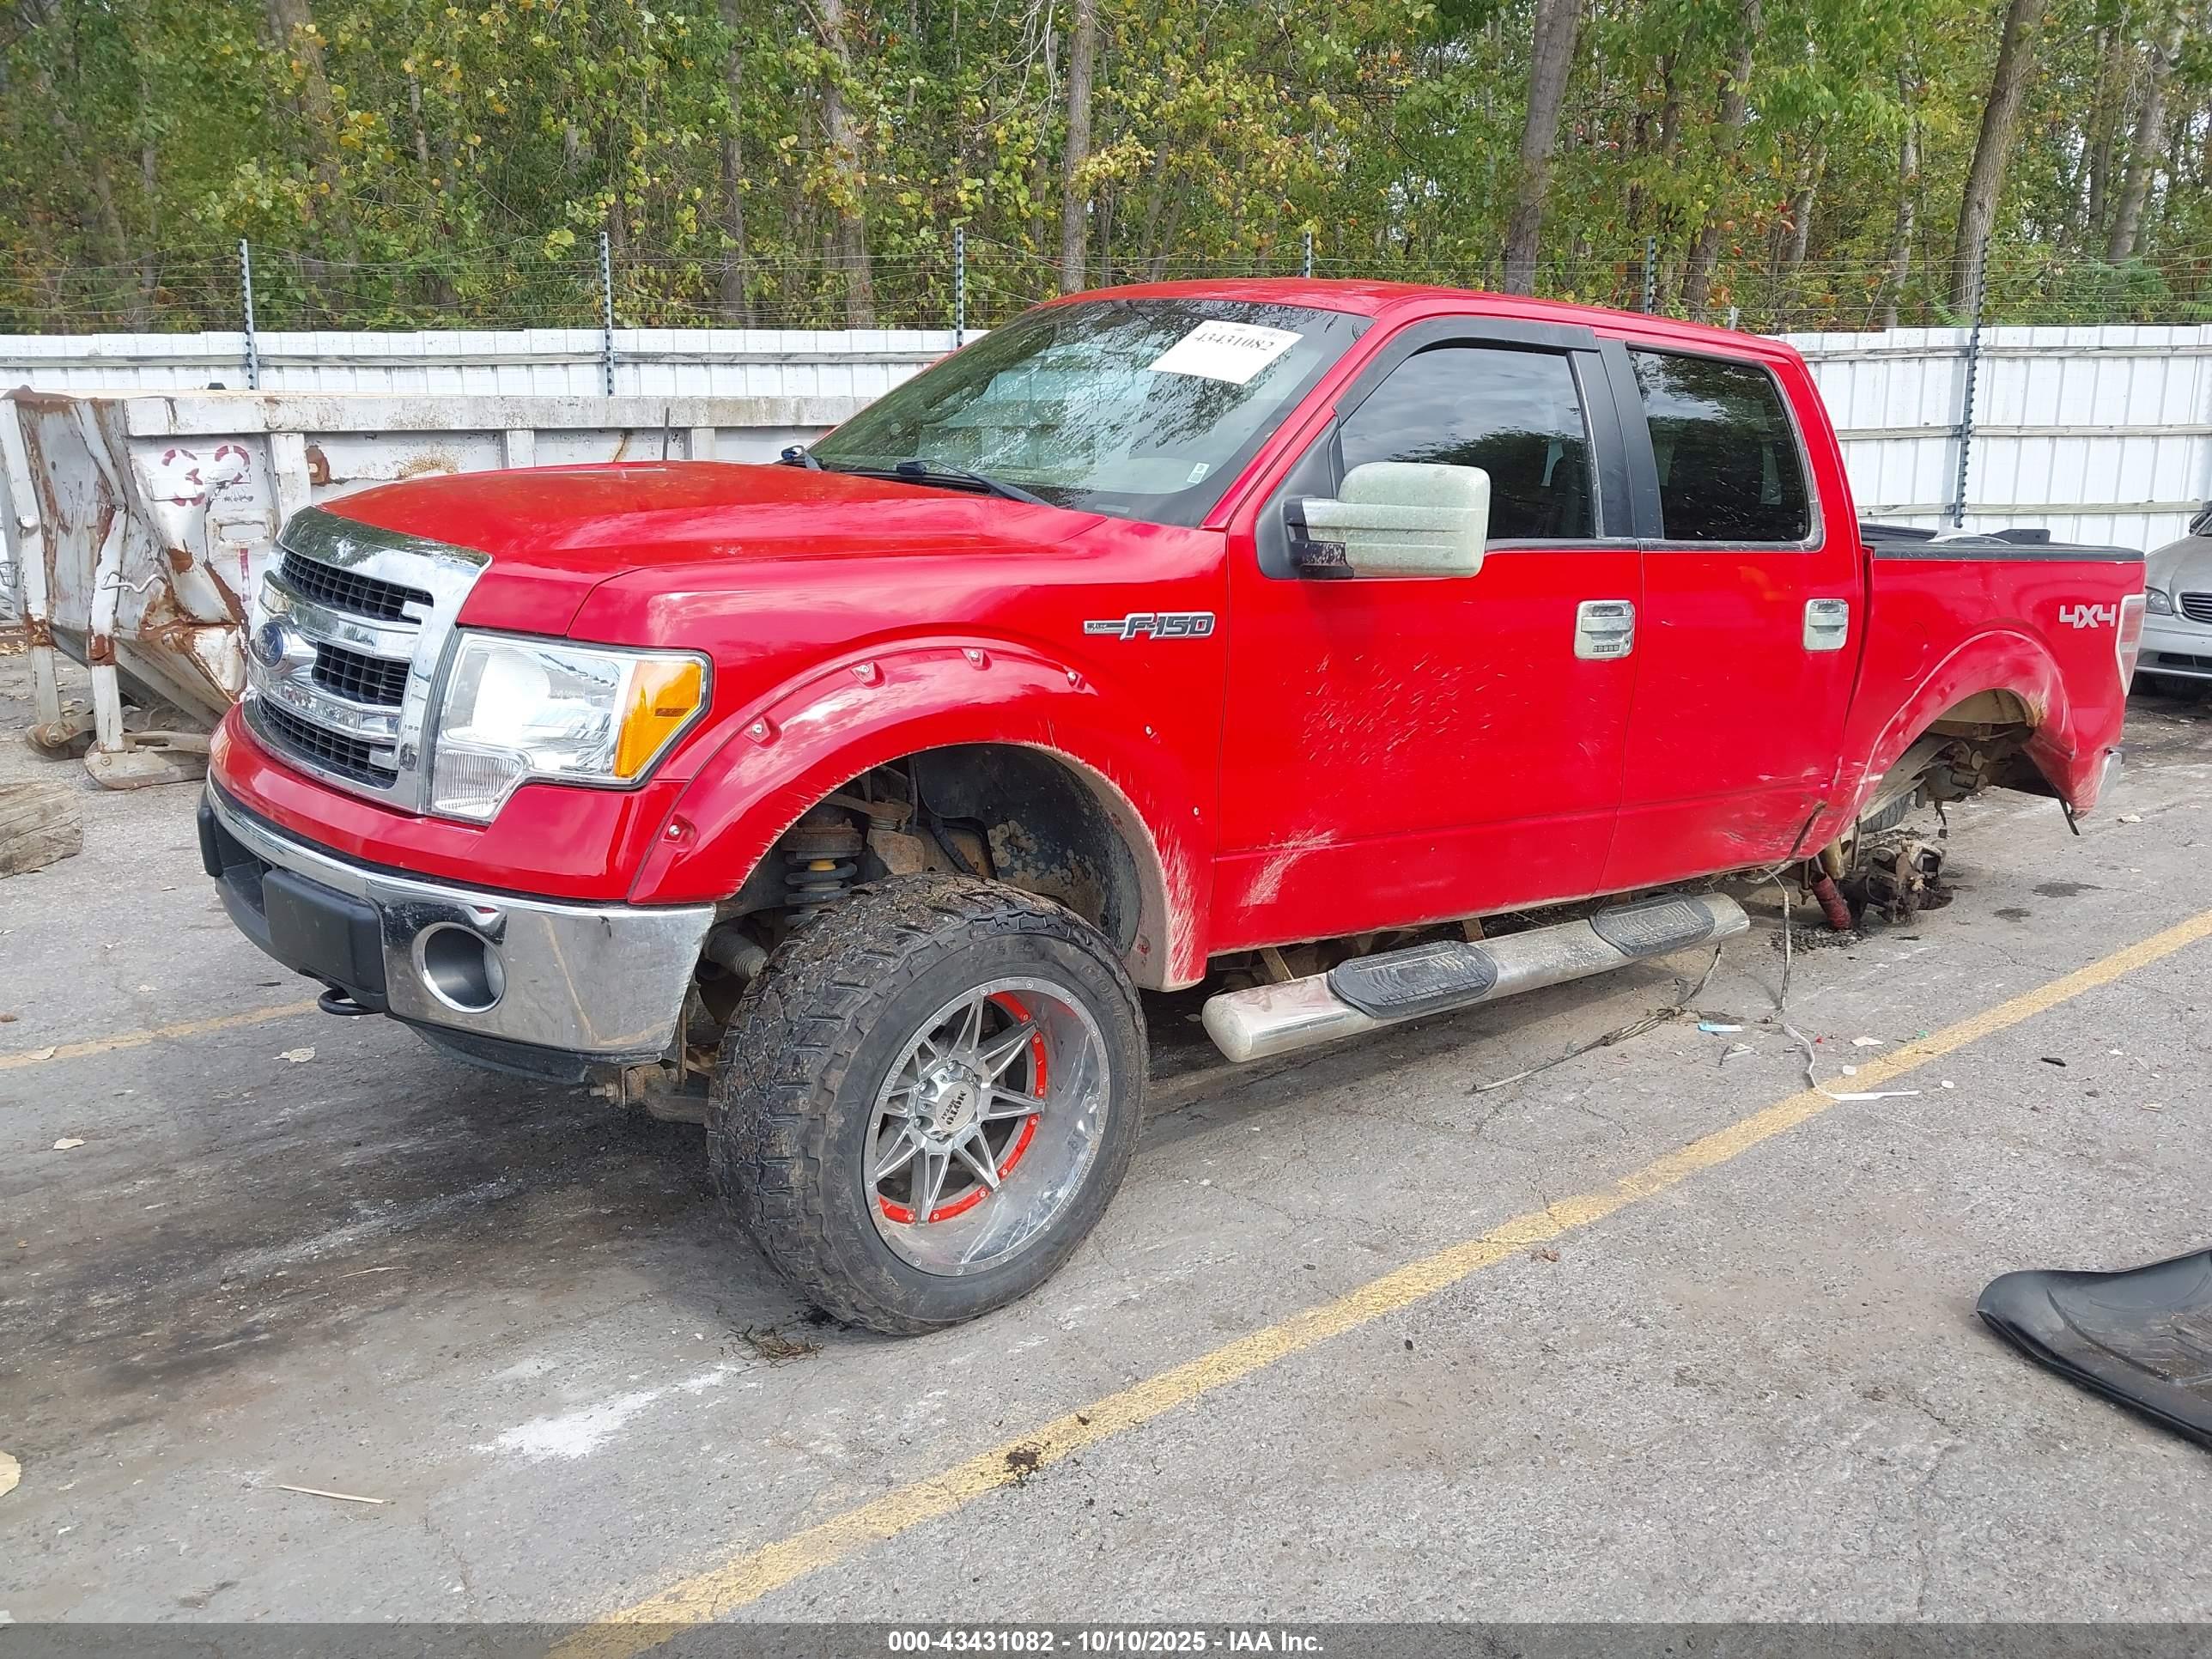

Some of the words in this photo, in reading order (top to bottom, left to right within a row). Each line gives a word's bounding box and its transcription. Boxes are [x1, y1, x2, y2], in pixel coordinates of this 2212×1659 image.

[1195, 332, 1275, 351] 43431082
[1119, 611, 1216, 641] F-150
[2058, 604, 2118, 629] 4X4
[945, 1089, 968, 1126] MOTO
